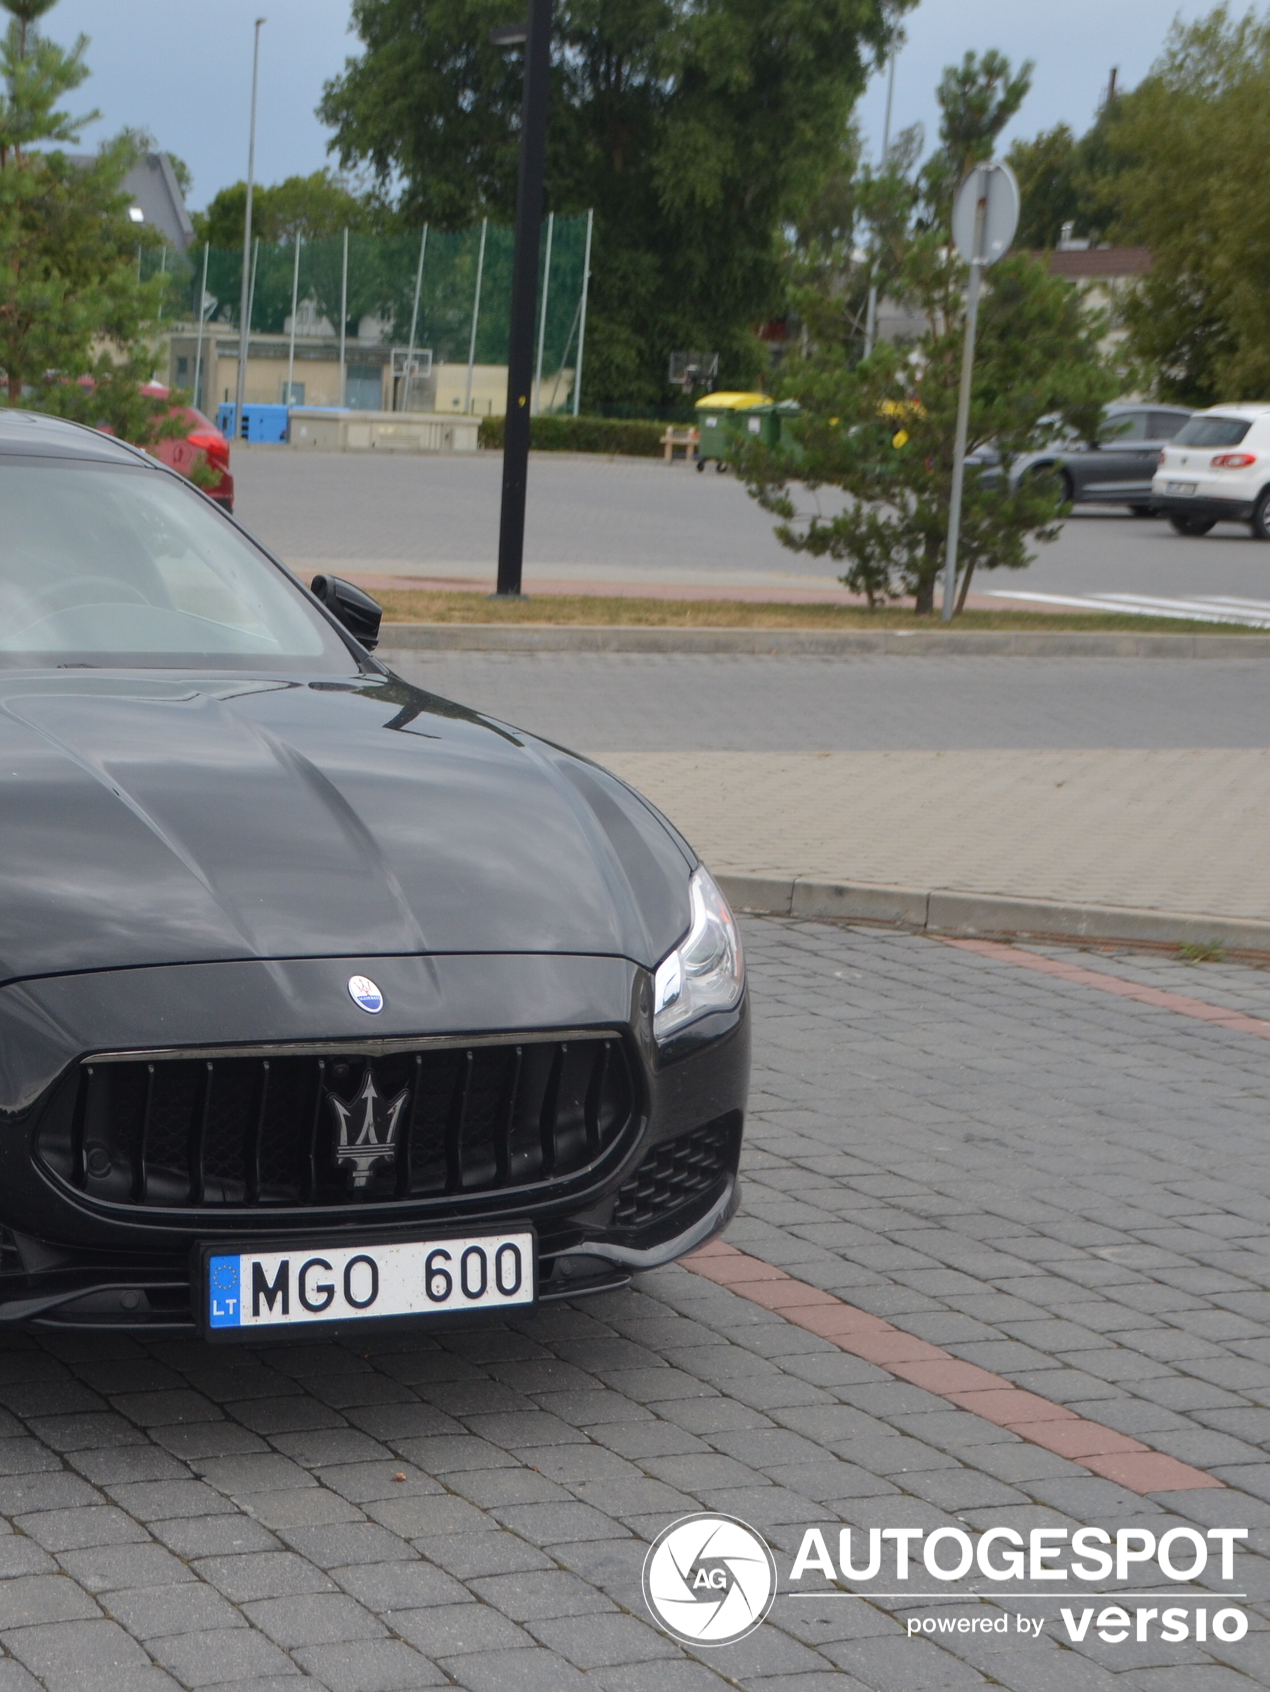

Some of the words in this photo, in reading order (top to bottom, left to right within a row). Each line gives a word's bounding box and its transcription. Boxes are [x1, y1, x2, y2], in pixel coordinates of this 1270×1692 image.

[251, 1255, 380, 1317] MGO
[424, 1242, 522, 1303] 600
[213, 1298, 237, 1316] LT
